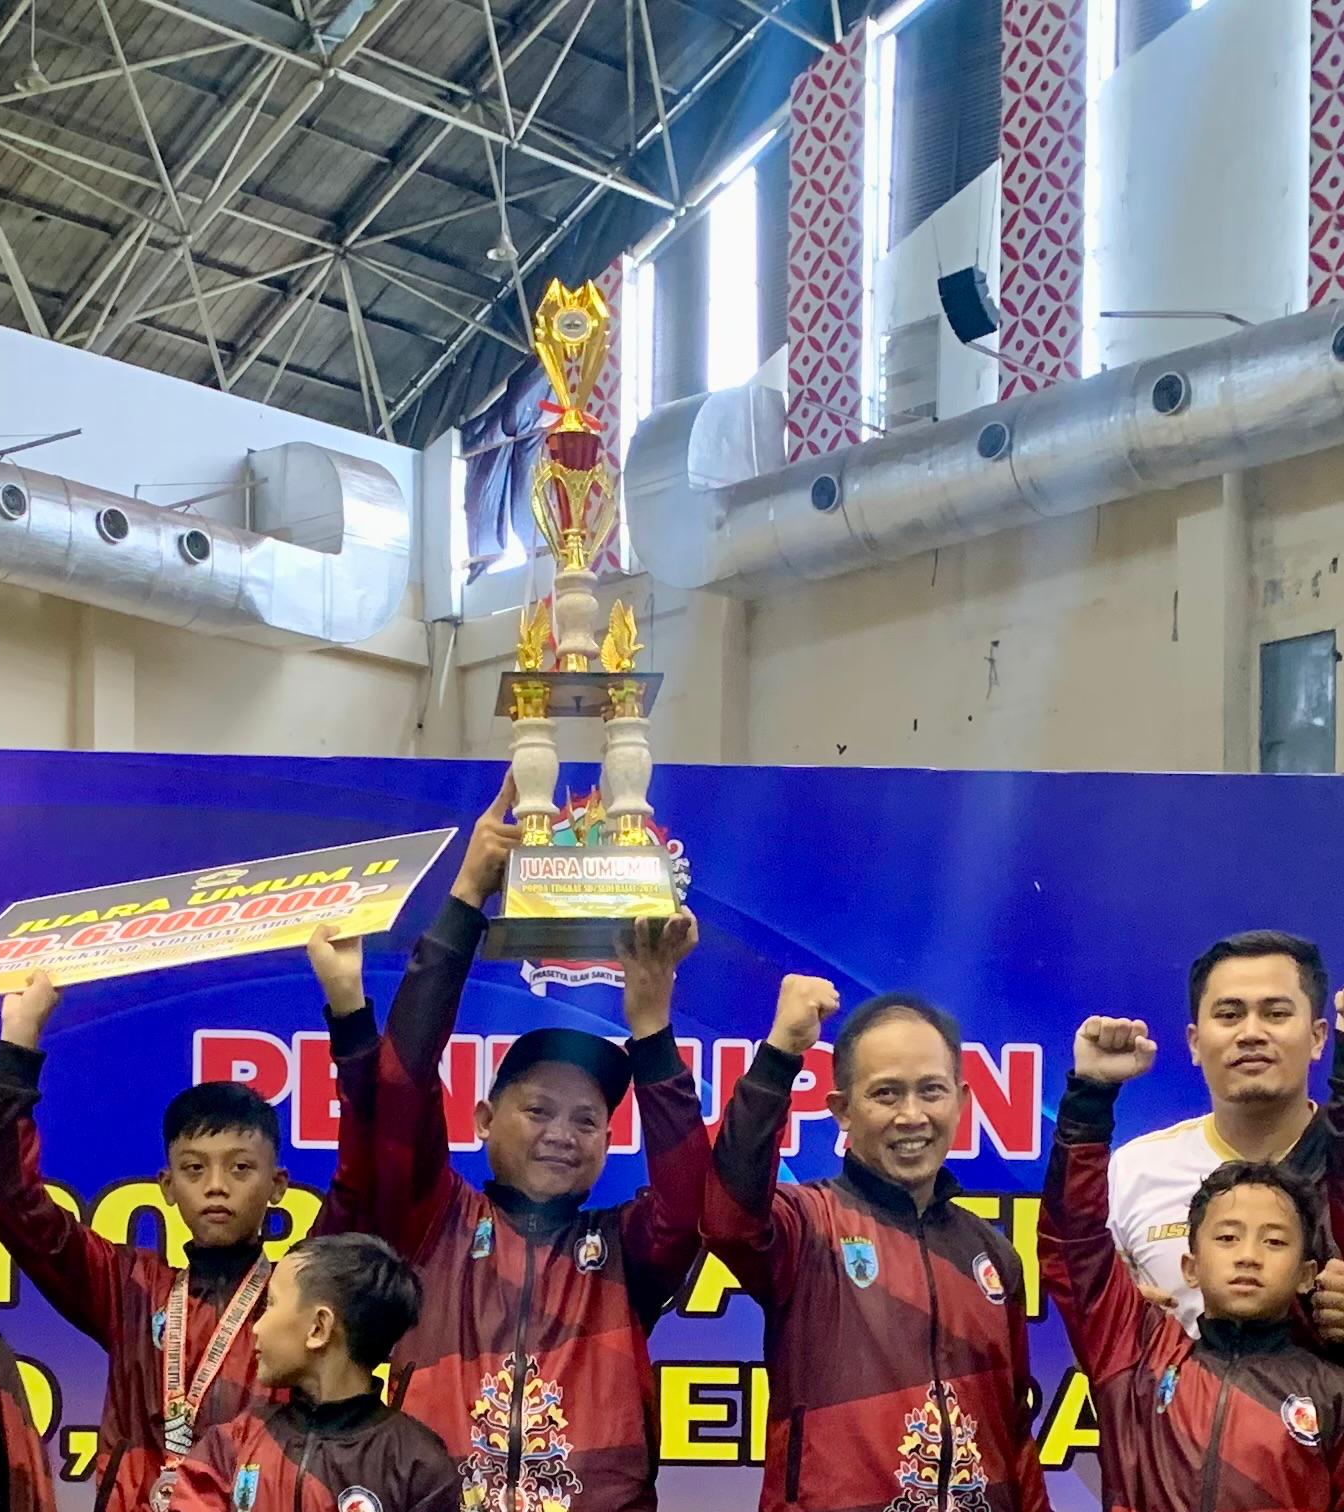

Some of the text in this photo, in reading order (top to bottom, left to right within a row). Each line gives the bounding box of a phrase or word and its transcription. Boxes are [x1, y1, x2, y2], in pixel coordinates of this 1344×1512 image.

[520, 858, 581, 880] JUARA
[8, 858, 400, 938] JUARA UMUM II
